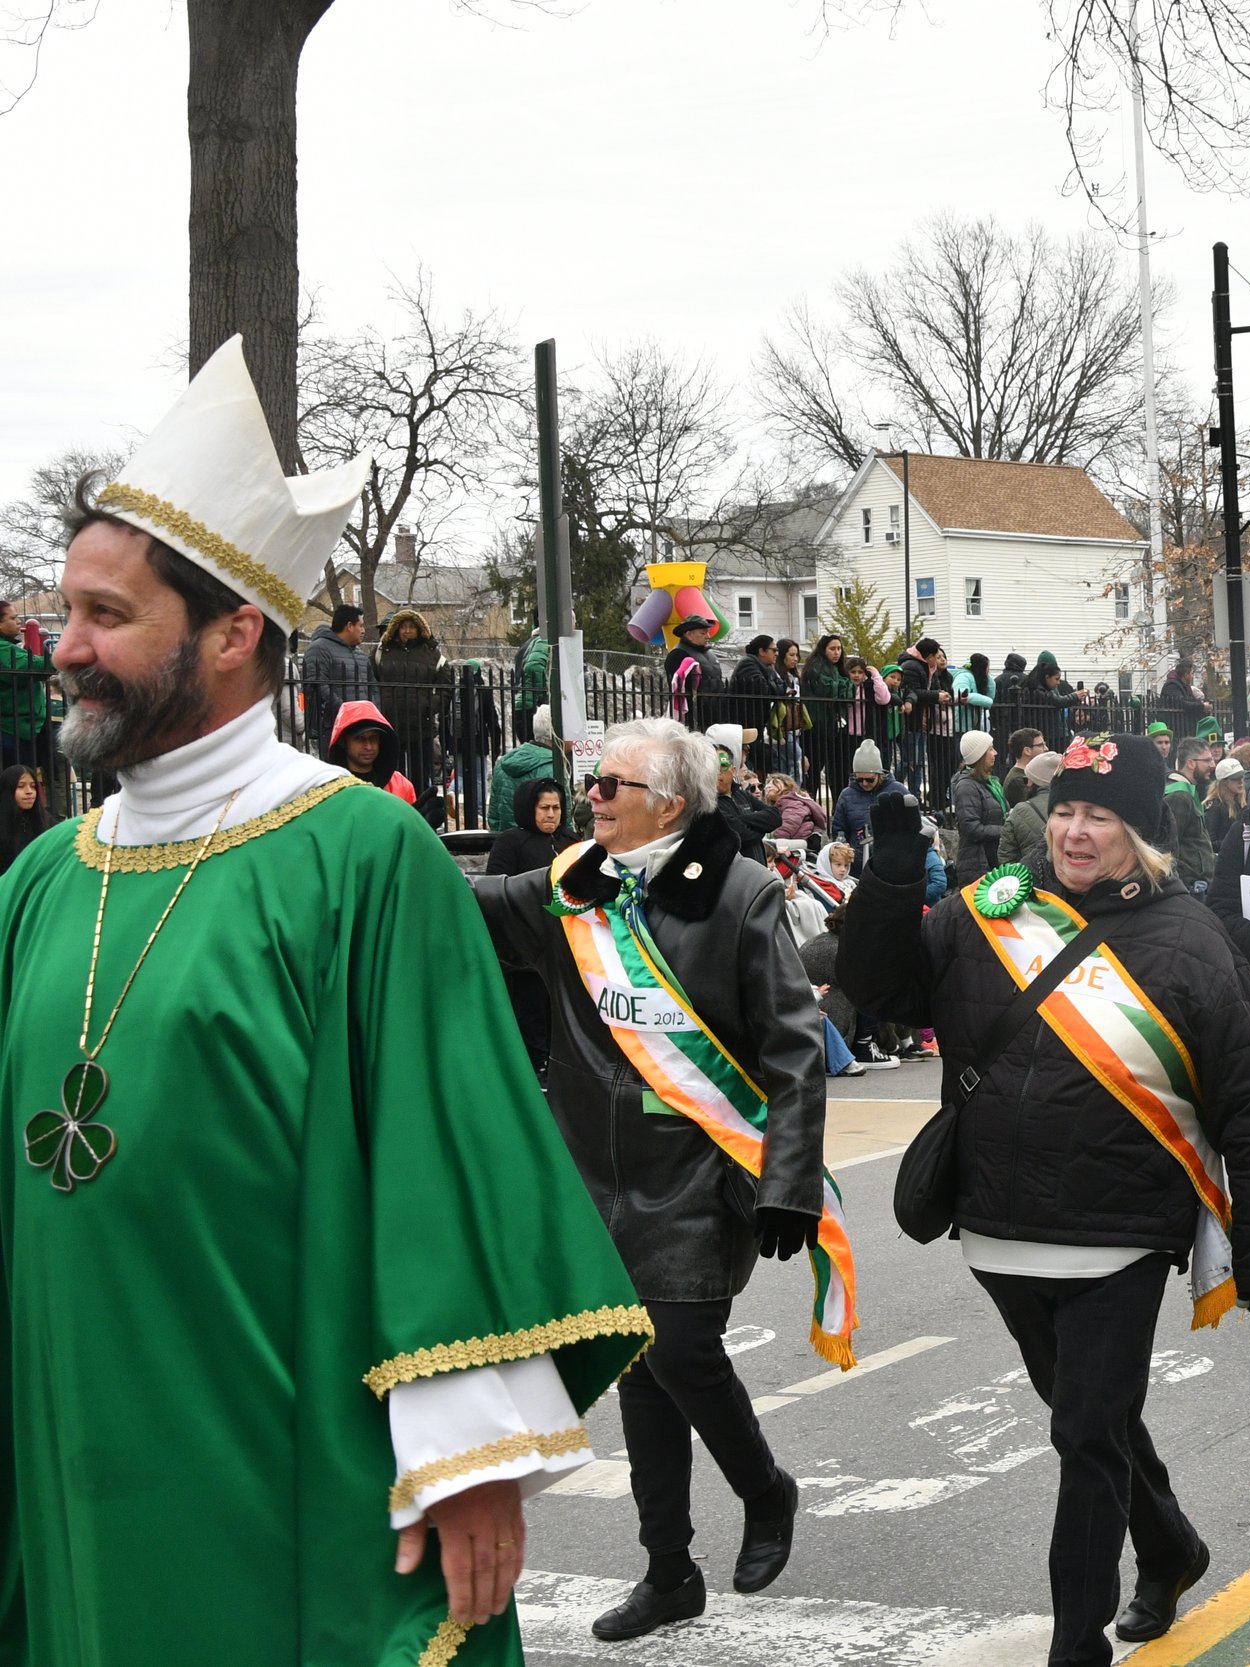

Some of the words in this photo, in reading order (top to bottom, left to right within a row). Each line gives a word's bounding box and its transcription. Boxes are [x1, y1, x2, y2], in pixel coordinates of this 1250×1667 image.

[1024, 954, 1110, 990] ADE
[597, 987, 647, 1025] AIDE
[654, 1012, 686, 1026] 2012
